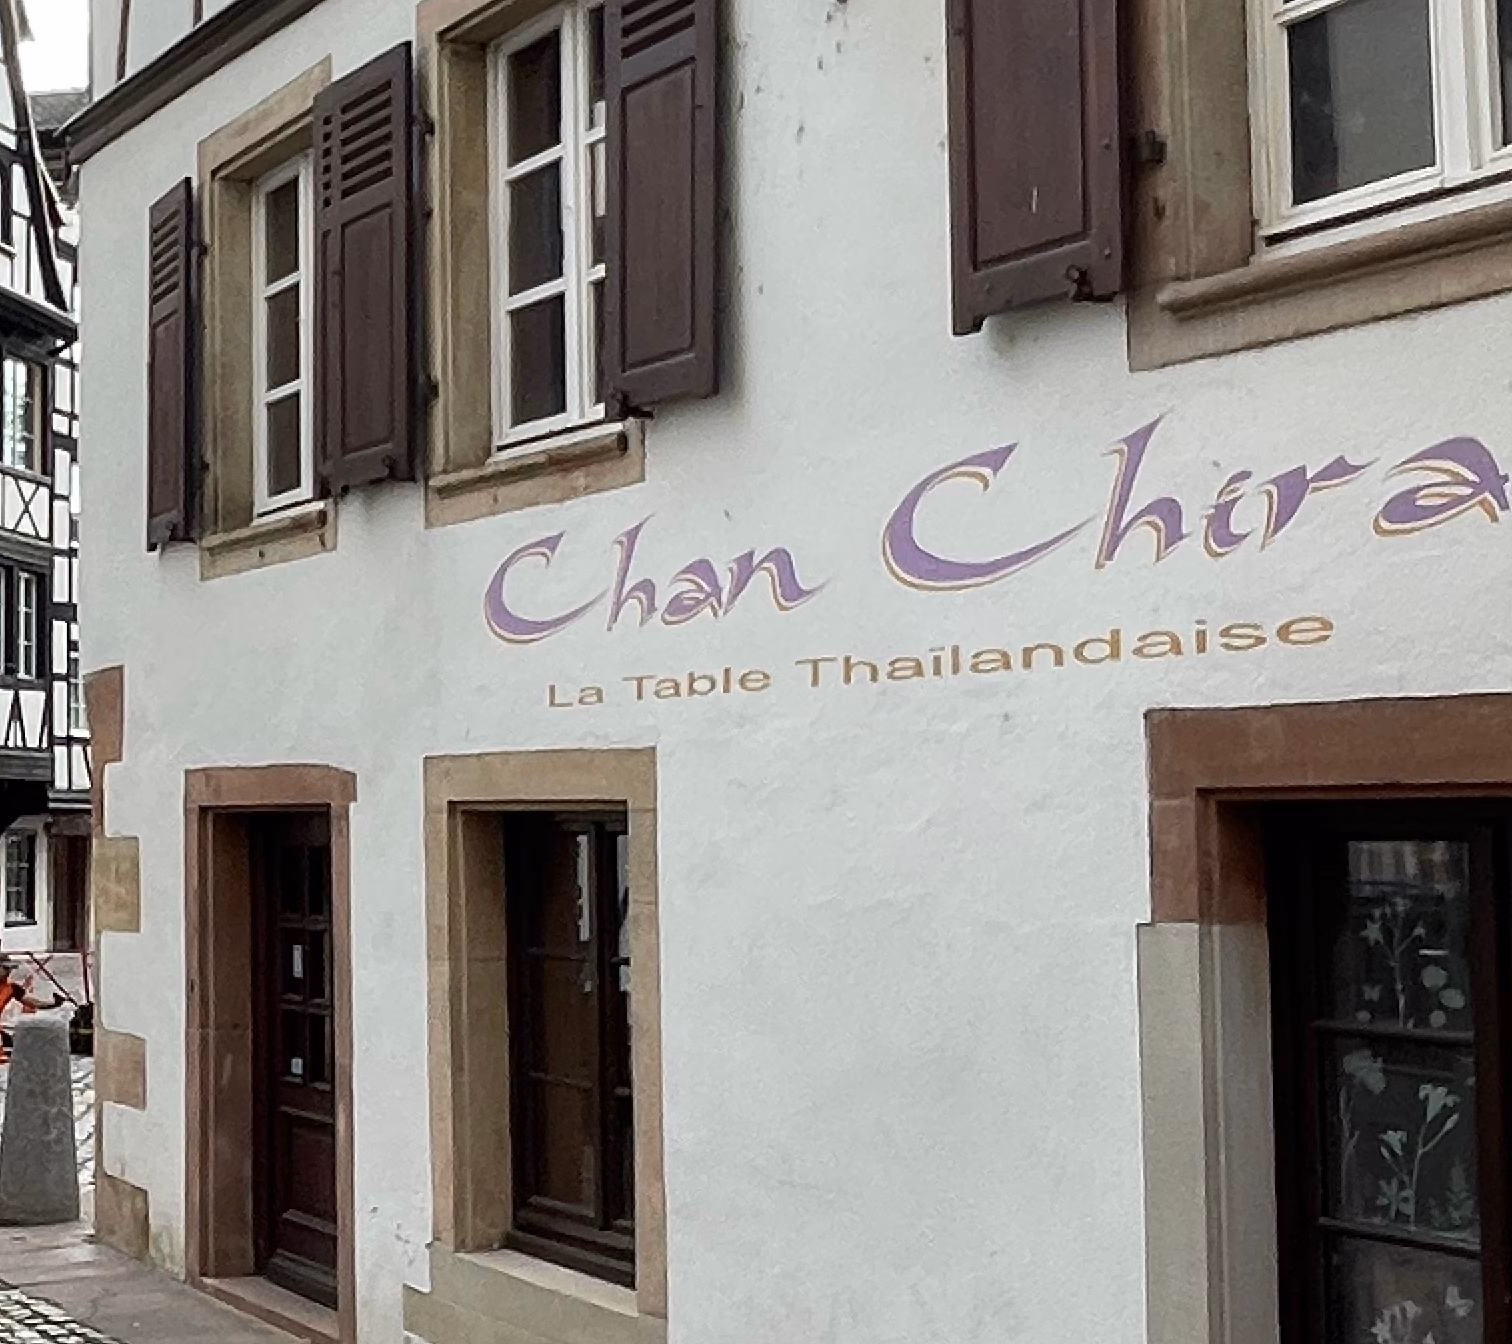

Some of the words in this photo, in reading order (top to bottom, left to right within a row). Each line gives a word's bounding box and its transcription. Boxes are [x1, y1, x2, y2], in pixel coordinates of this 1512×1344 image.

[483, 512, 831, 645] Chan
[881, 405, 1510, 593] Chira
[547, 684, 605, 709] La
[622, 666, 773, 702] Table
[794, 613, 1336, 689] Thaïlandaise
